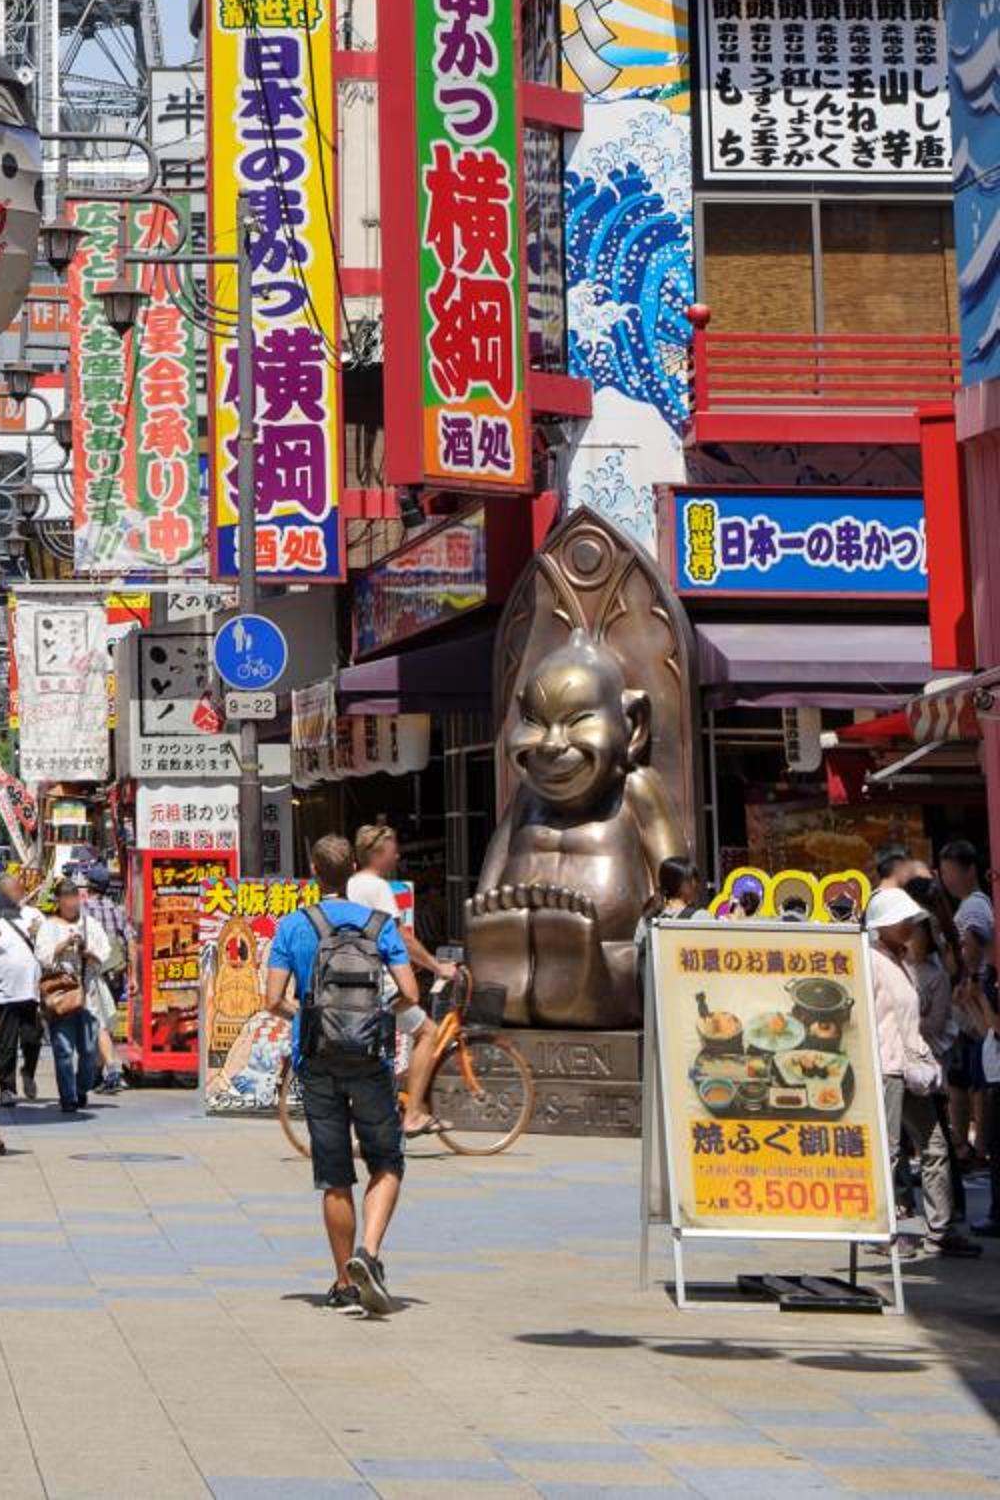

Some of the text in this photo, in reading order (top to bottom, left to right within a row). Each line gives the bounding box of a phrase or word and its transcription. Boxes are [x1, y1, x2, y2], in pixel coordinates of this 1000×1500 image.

[716, 68, 745, 167] もち
[750, 68, 780, 167] うずら玉子
[780, 68, 814, 167] 紅しょうが
[812, 68, 844, 167] にんにく
[847, 68, 878, 167] 玉ねぎ
[880, 68, 911, 167] 山芋
[914, 68, 946, 167] しし唐
[224, 36, 326, 517] 日本一の串かつ 横綱
[424, 145, 513, 406] 横綱
[441, 415, 513, 472] 酒処
[687, 504, 714, 581] 新世界
[720, 519, 918, 568] 日本一の串かつ
[692, 1123, 866, 1159] 焼ふぐ御膳
[734, 1180, 869, 1214] 3,500円
